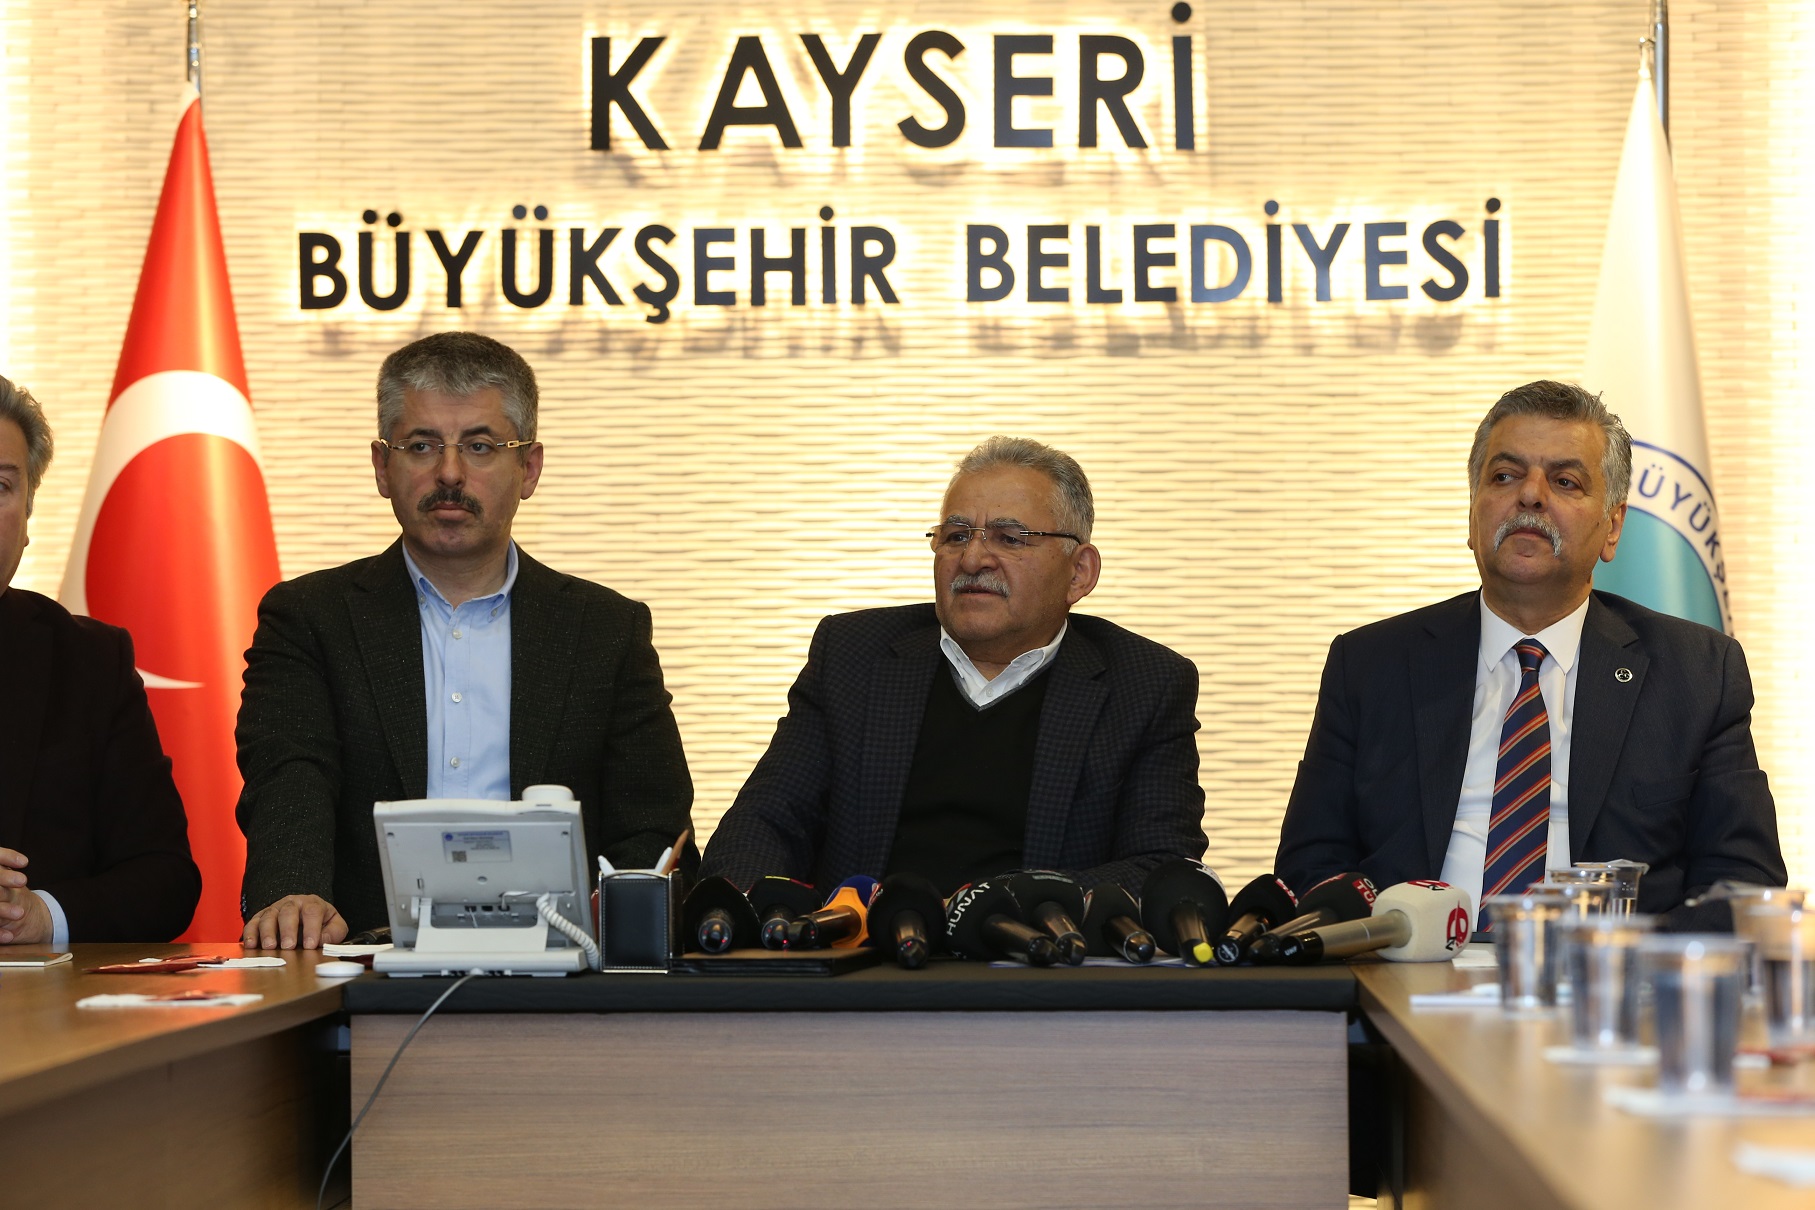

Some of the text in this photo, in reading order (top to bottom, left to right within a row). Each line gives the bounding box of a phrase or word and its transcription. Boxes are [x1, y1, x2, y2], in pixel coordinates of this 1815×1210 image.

[590, 1, 1195, 151] KAYSERİ
[299, 197, 1501, 324] BÜYÜKŞEHİR BELEDİYESİ
[946, 881, 991, 936] HUNAT
